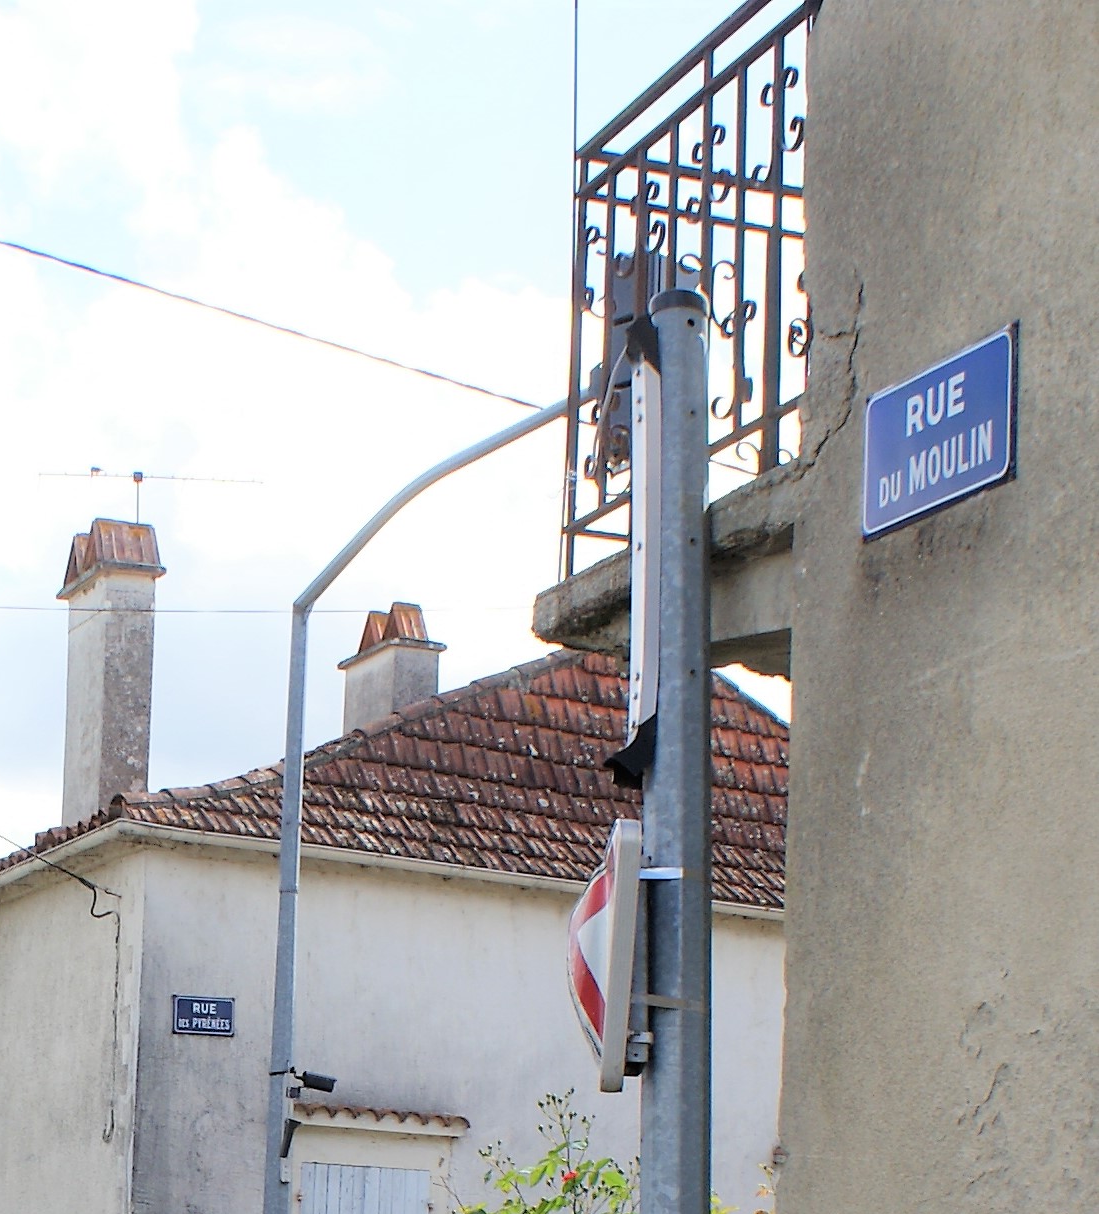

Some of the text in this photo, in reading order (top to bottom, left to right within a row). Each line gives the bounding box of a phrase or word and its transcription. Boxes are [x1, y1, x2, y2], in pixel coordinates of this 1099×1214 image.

[905, 371, 965, 437] RUE
[878, 419, 993, 509] DU MOULIN
[178, 1018, 189, 1029] DES
[192, 1002, 217, 1015] RUE
